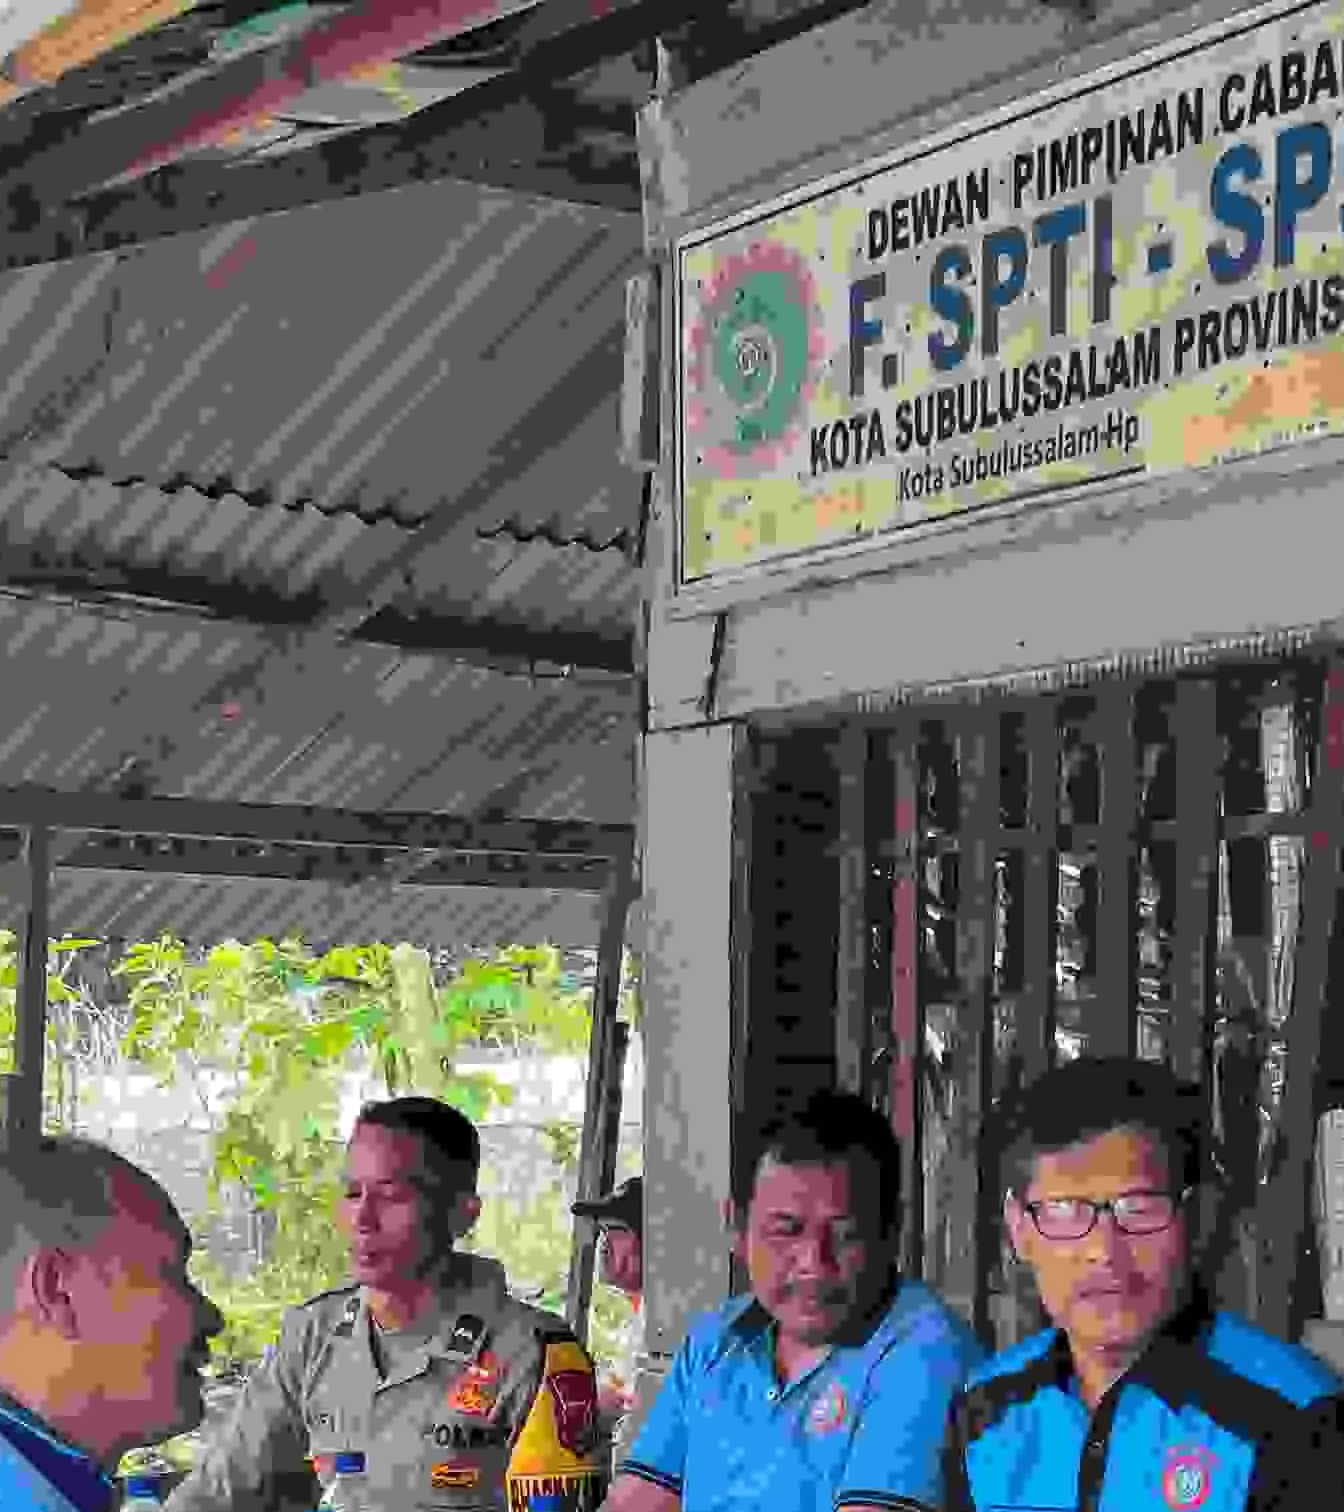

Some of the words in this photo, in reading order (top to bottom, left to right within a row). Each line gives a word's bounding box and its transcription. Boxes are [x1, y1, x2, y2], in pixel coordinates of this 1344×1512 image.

[867, 167, 989, 260] DEWAN
[1013, 87, 1204, 209] PIMPINAN
[927, 191, 1113, 371] SPTI
[809, 408, 886, 477] KOTA
[895, 327, 1161, 452] SUBULUSSALAM
[898, 463, 944, 501] Kota
